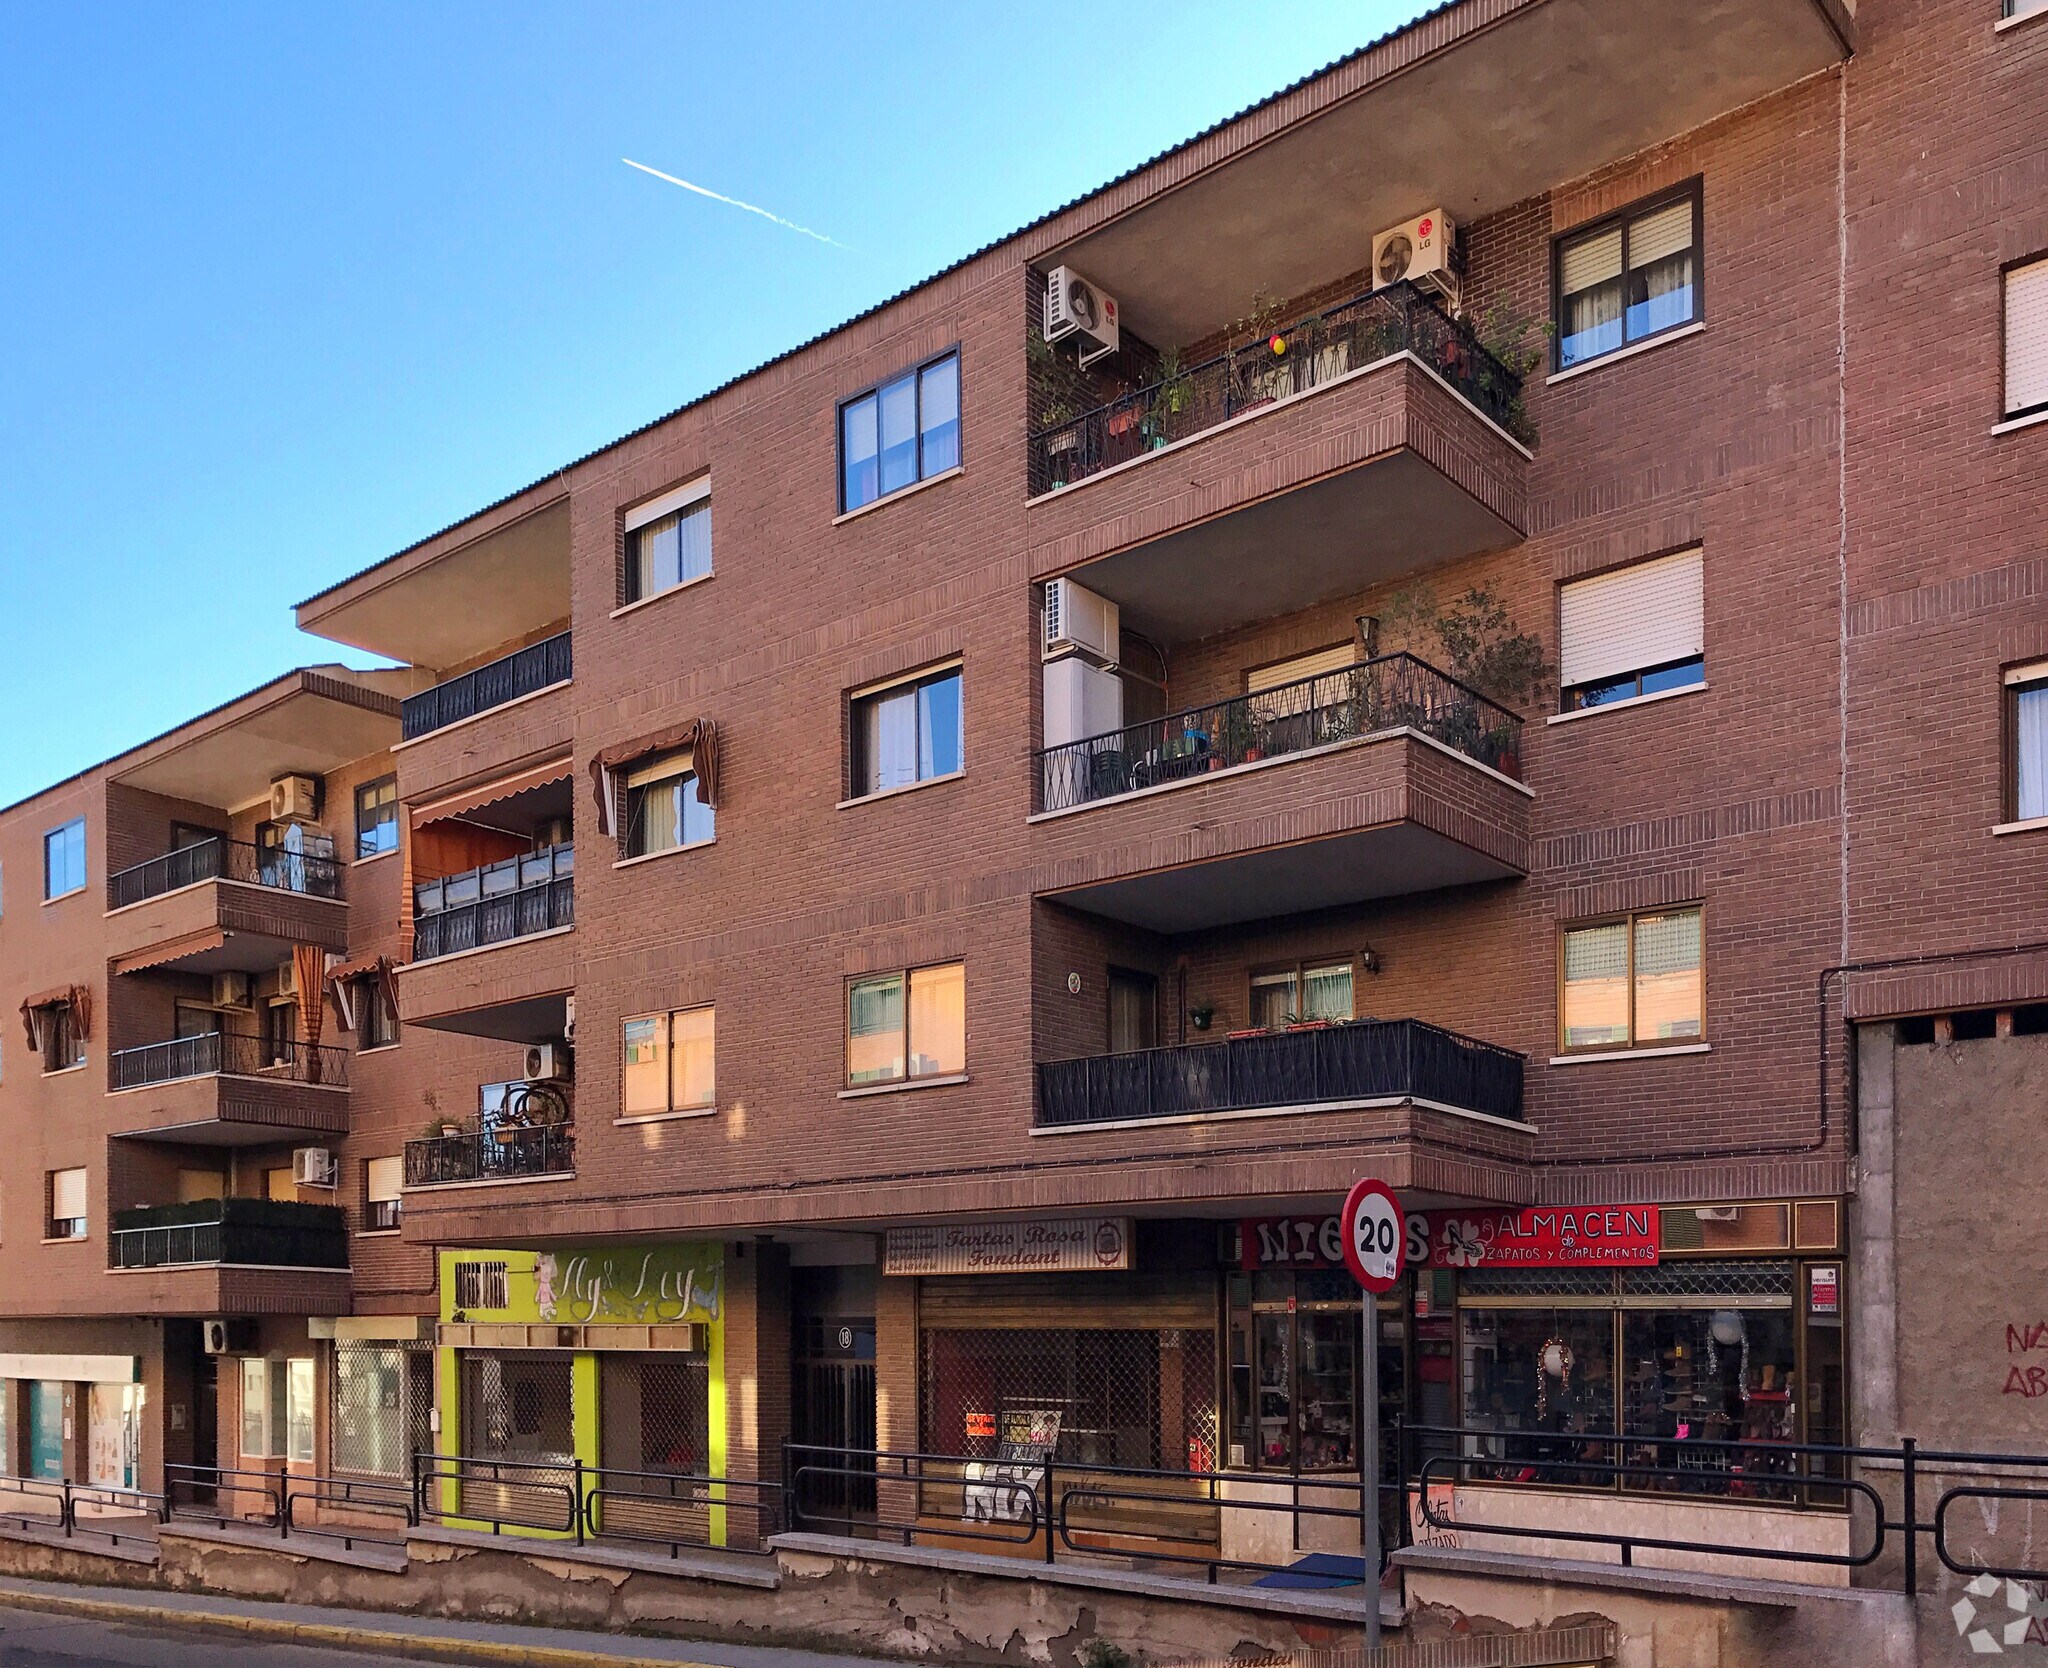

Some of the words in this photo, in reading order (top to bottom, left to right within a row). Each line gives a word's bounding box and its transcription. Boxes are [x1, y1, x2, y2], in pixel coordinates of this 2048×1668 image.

[1419, 239, 1431, 251] LG
[1106, 315, 1115, 327] LG
[1498, 1207, 1649, 1238] ALMACÉN
[945, 1230, 1015, 1248] Tartas
[1024, 1226, 1088, 1244] Rosa
[1360, 1216, 1394, 1255] 20
[1561, 1235, 1576, 1248] de
[967, 1248, 1061, 1267] Fondant
[1486, 1248, 1541, 1261] ZAPATOS
[1559, 1246, 1655, 1261] COMPLEMENTOS
[841, 1331, 849, 1345] 18
